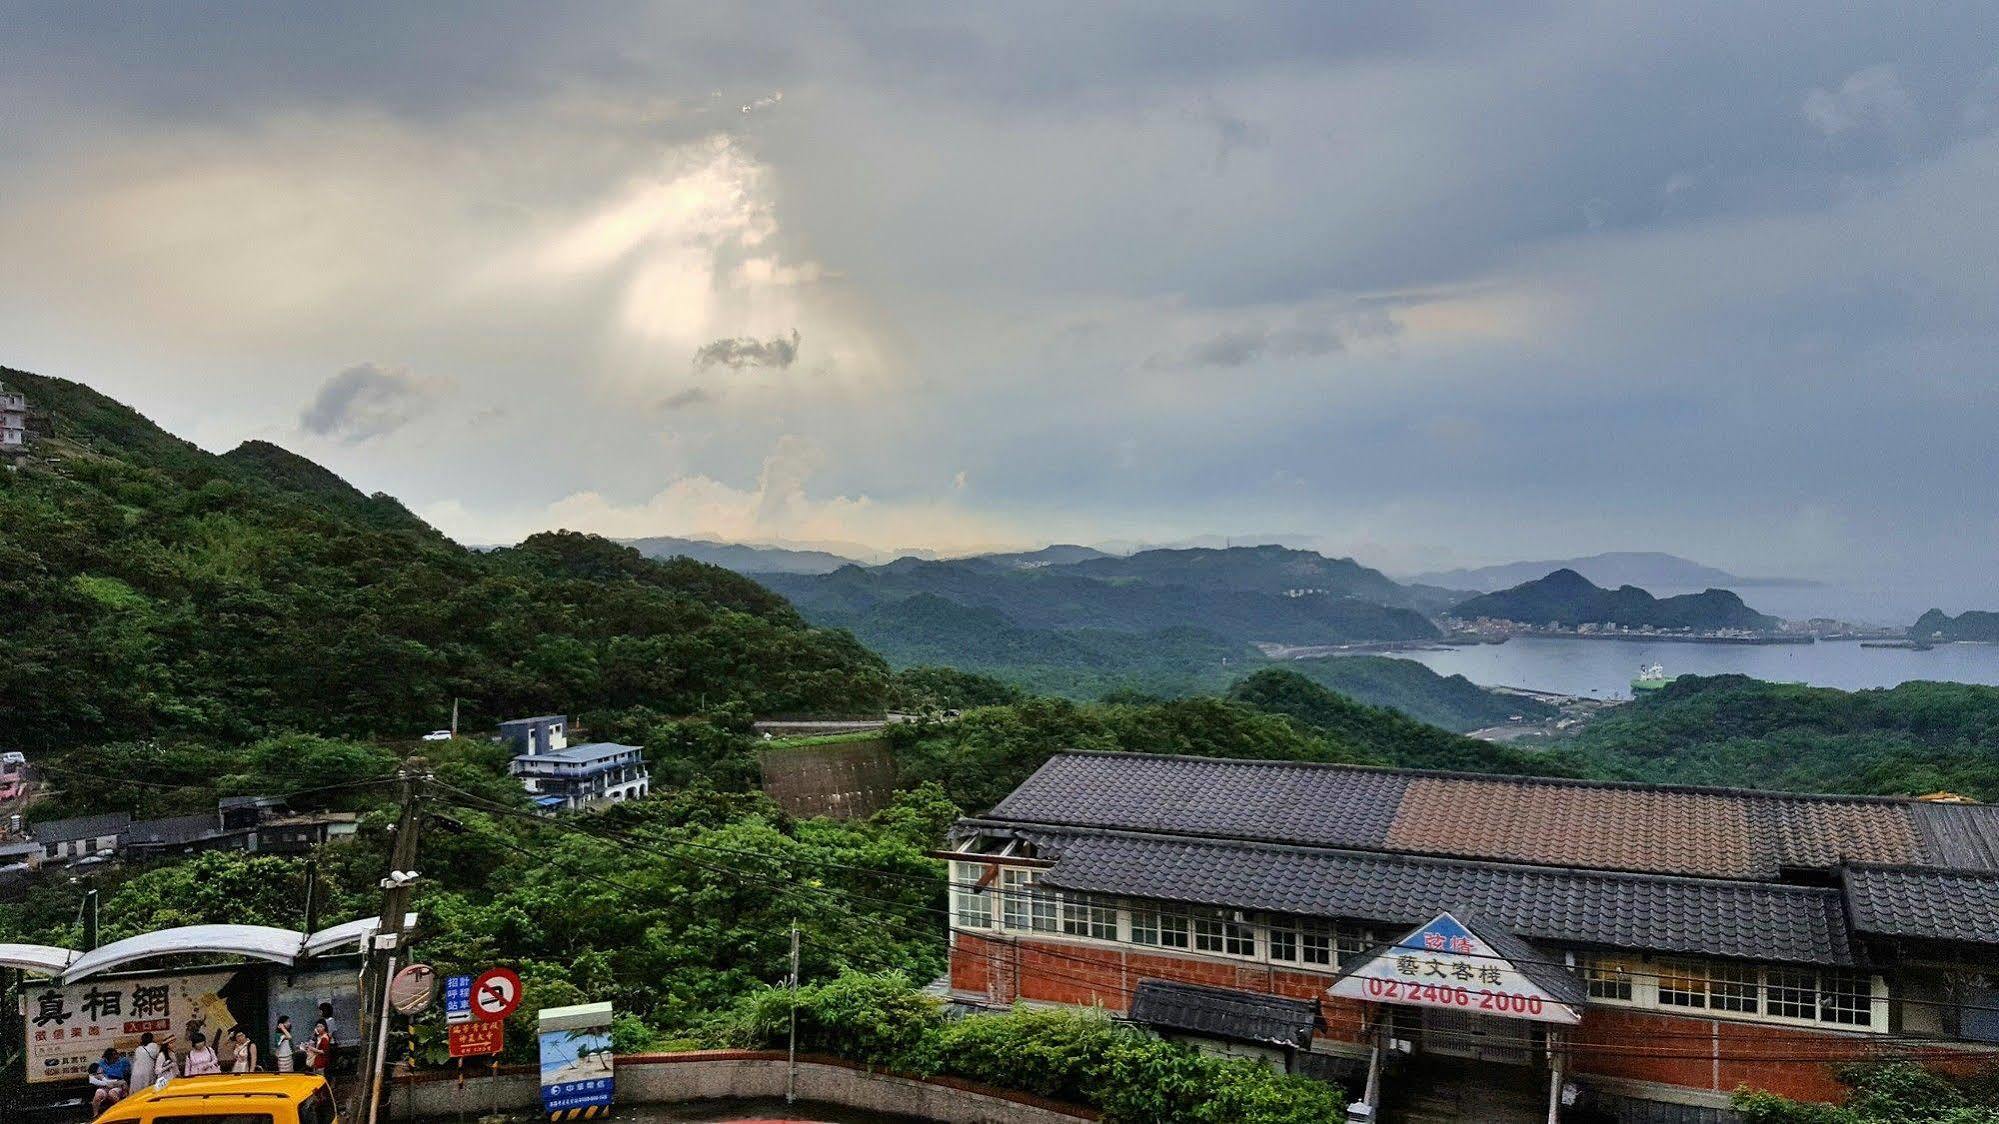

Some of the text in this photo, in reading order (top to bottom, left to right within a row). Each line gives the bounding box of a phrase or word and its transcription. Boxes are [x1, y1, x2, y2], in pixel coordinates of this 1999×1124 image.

[1397, 955, 1504, 986] 藝文客棧
[32, 985, 169, 1026] 真相網
[1362, 976, 1543, 1015] (02)2406-2000
